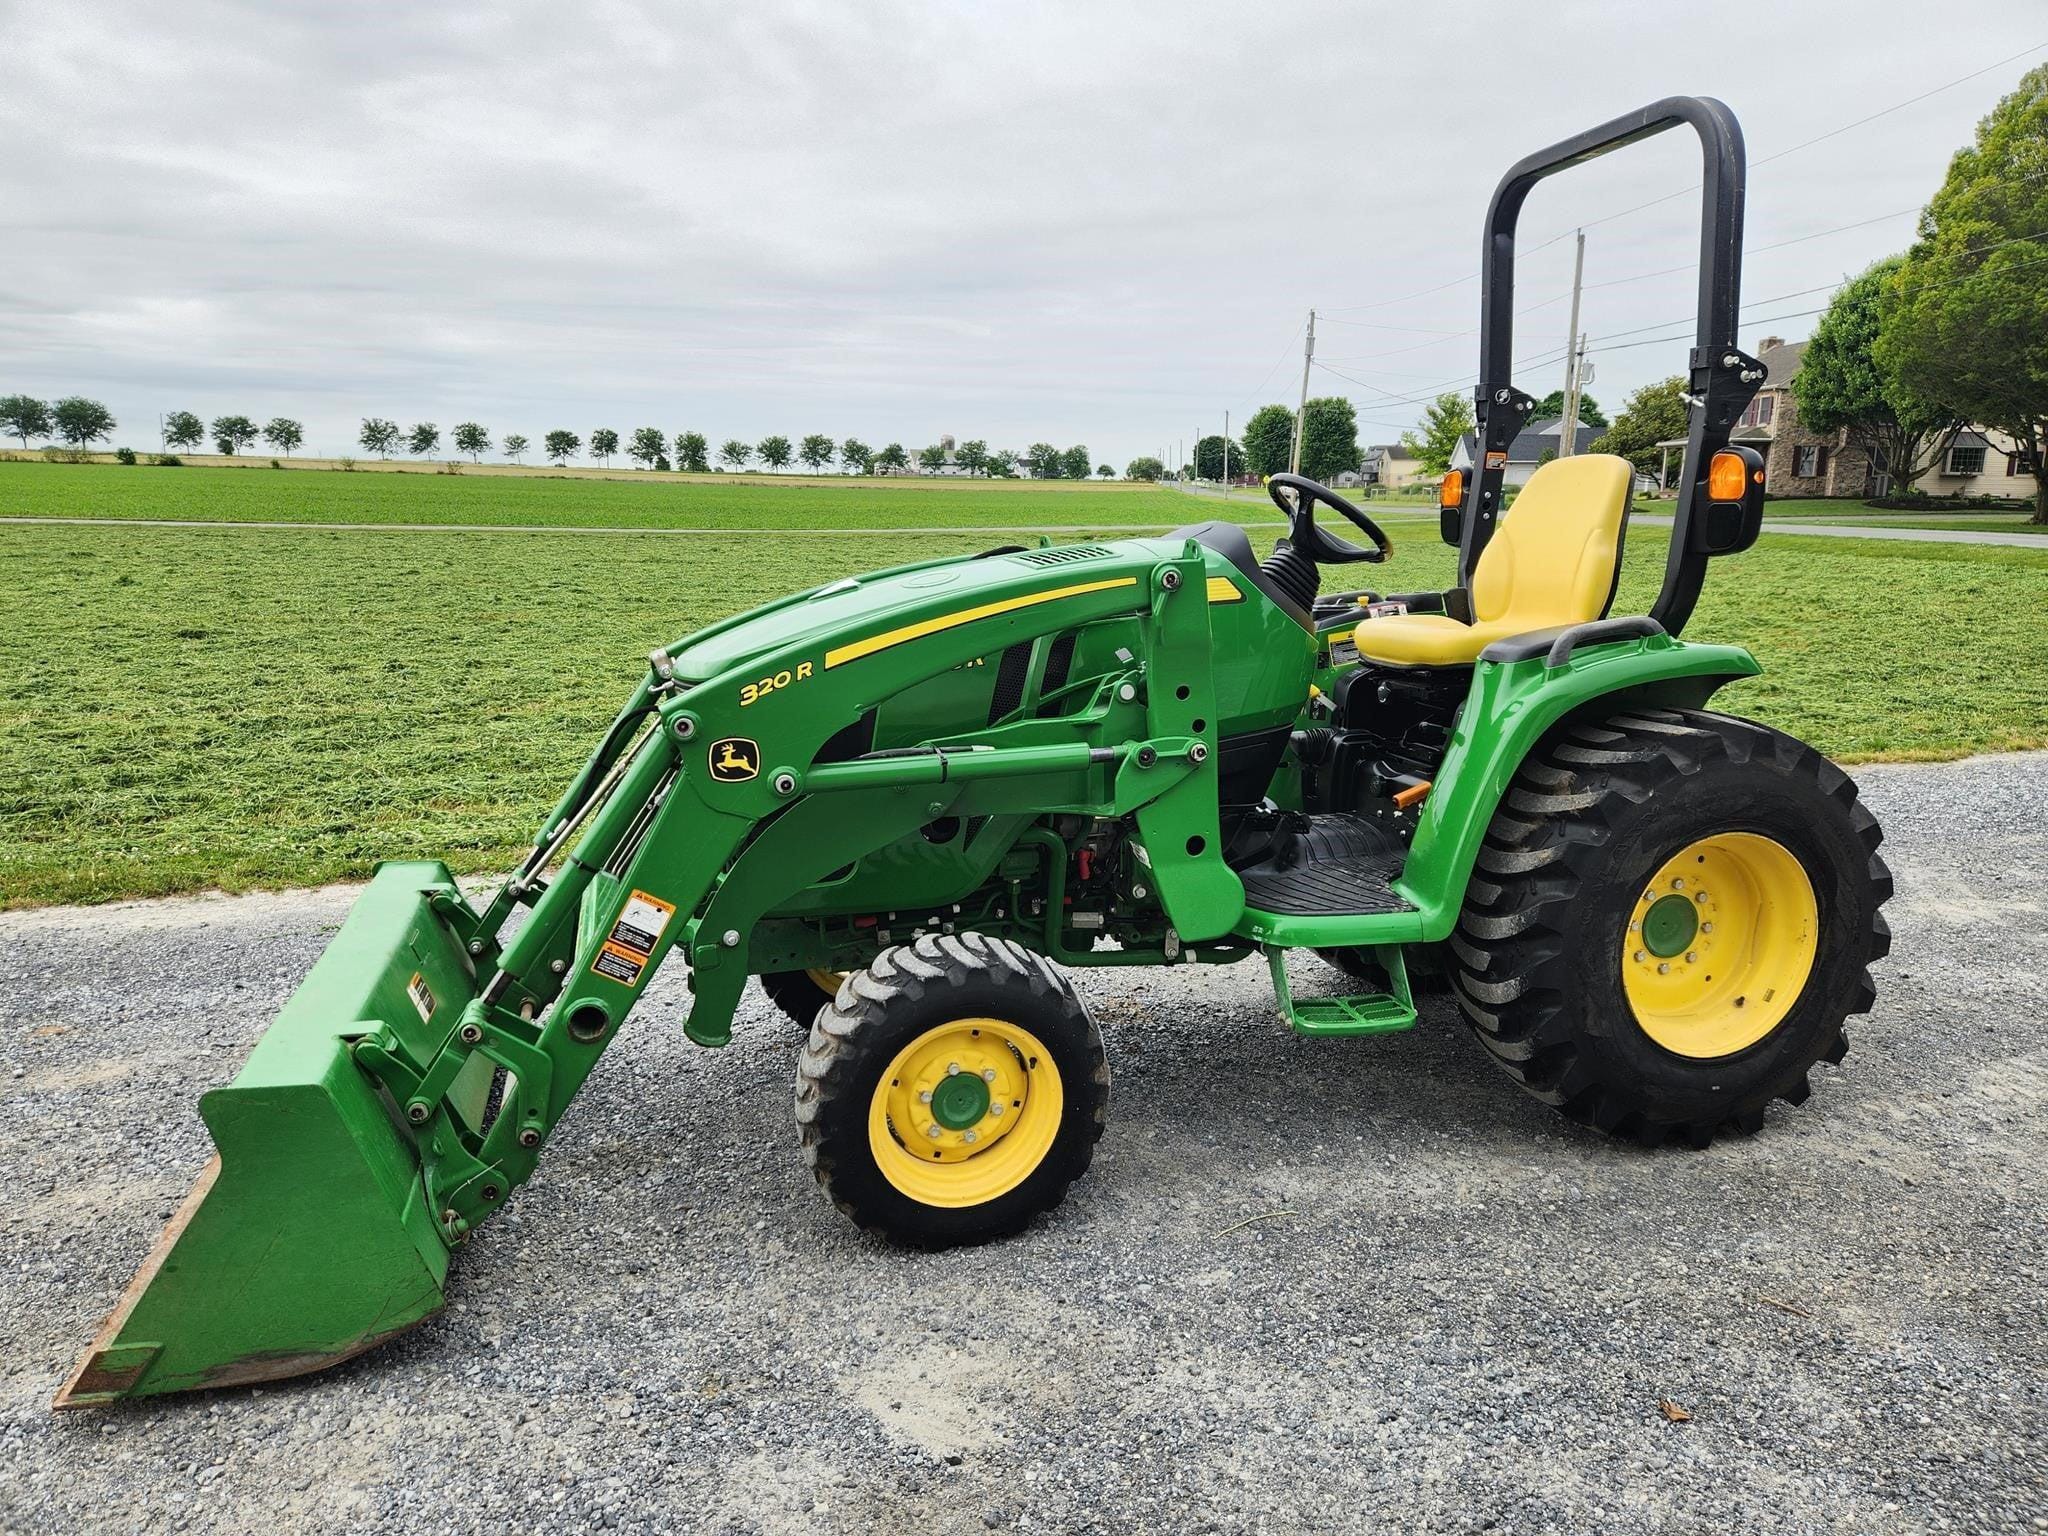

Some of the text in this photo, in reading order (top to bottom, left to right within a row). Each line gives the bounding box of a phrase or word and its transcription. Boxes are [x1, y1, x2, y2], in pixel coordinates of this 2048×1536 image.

[740, 661, 814, 706] 320 R
[615, 949, 642, 963] WARNING
